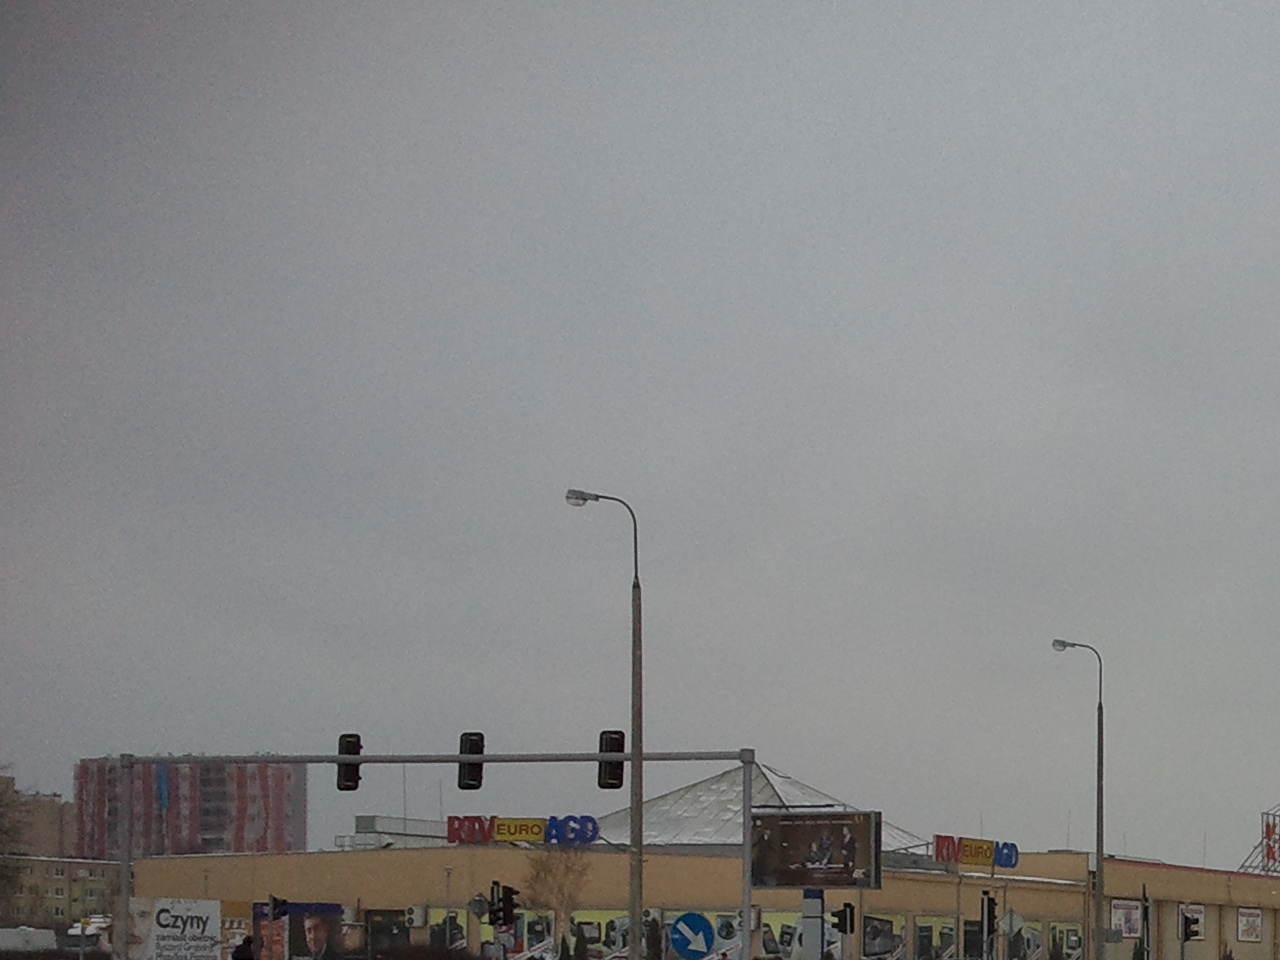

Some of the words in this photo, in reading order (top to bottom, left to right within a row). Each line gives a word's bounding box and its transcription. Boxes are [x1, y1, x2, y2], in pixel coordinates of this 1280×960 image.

[447, 815, 498, 843] RTV
[496, 823, 542, 836] EURO
[963, 844, 993, 859] EURO
[155, 908, 209, 935] Czyny
